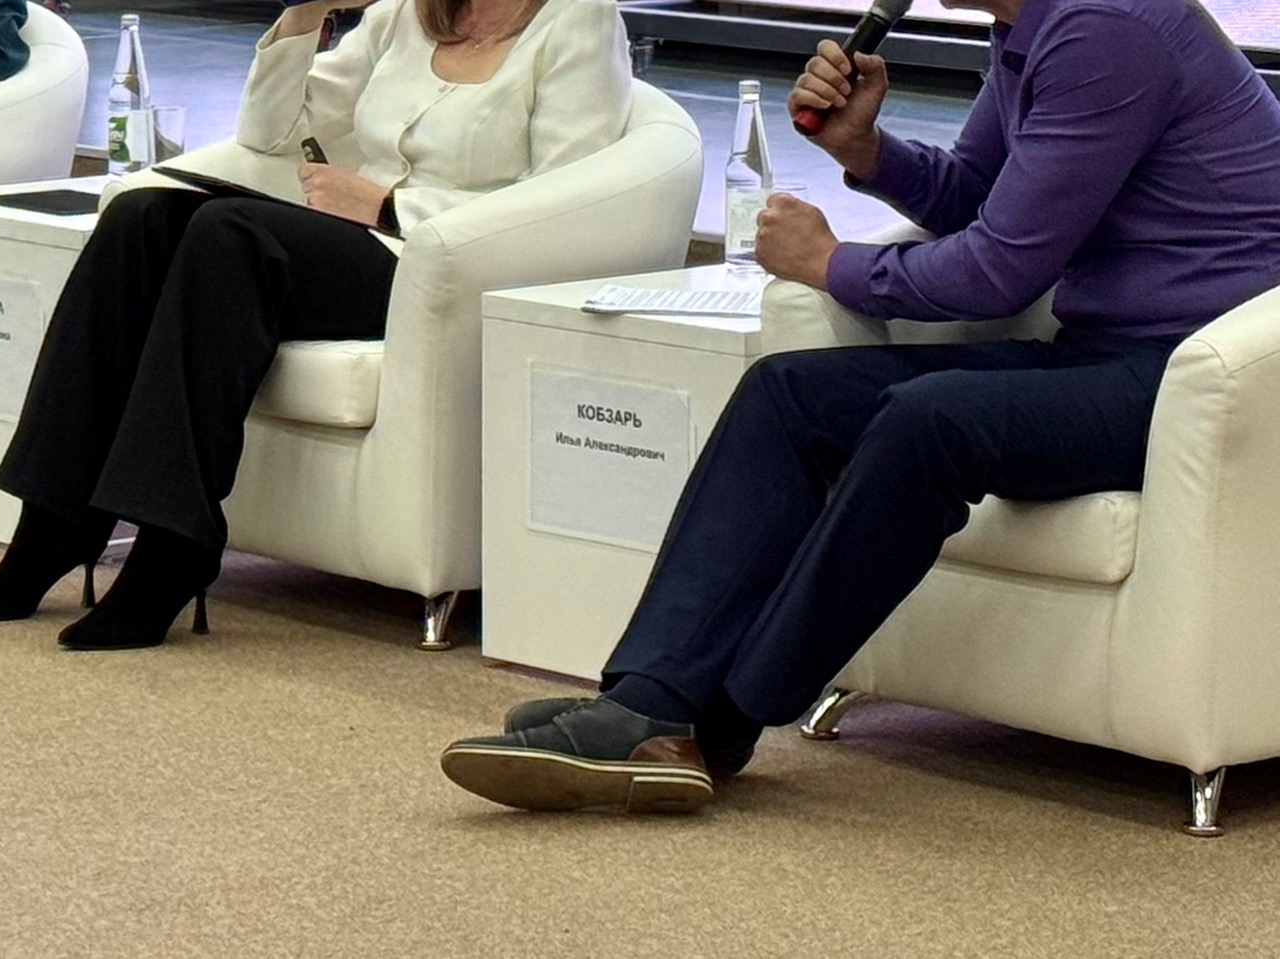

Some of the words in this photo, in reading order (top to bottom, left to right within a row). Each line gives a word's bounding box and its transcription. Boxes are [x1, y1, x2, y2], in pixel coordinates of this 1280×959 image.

[576, 403, 643, 428] КОБЗАРЬ
[555, 431, 582, 447] Илья
[583, 436, 665, 461] Александрович
